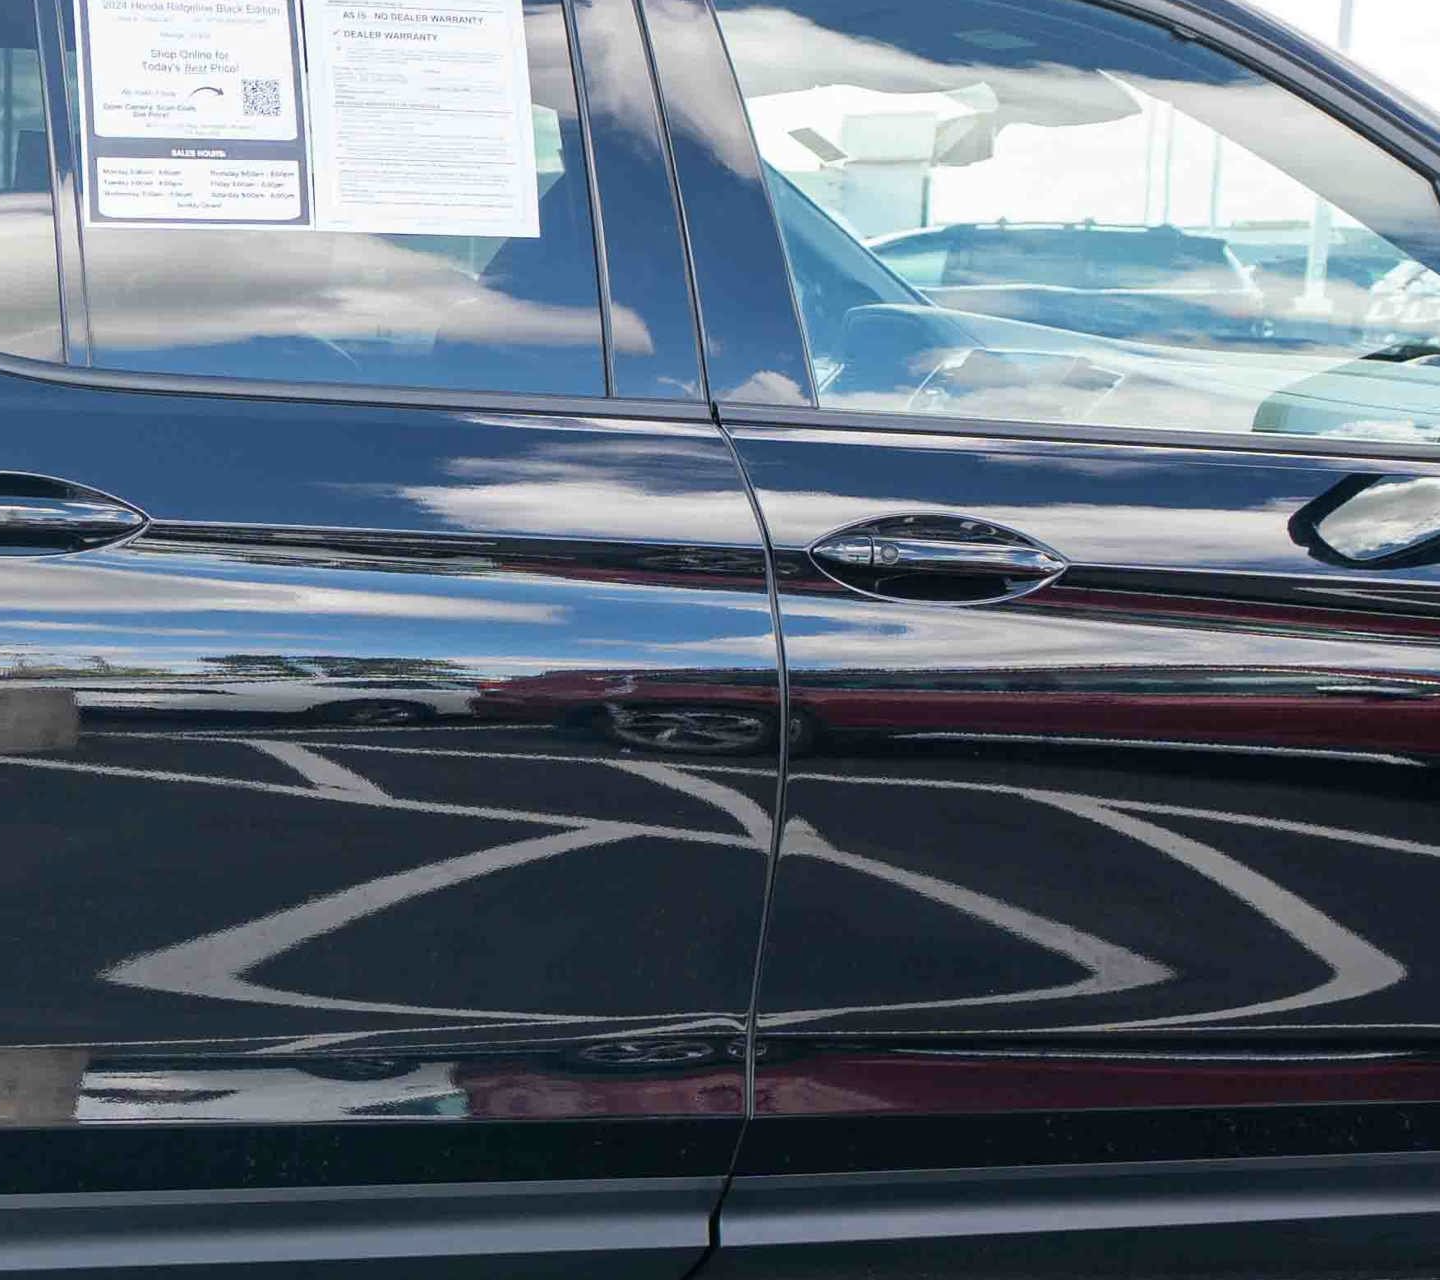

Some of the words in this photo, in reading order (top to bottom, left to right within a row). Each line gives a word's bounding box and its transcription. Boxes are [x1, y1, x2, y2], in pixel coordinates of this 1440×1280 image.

[103, 0, 127, 10] 2024
[131, 0, 164, 11] Honda
[216, 2, 242, 13] Black
[246, 3, 280, 16] Edition
[390, 13, 428, 23] DEALER
[430, 14, 483, 25] WARRANTY
[343, 29, 381, 40] DEALER
[383, 31, 438, 42] WARRANTY
[150, 49, 177, 61] Shop
[179, 50, 212, 60] Online
[215, 50, 229, 60] for
